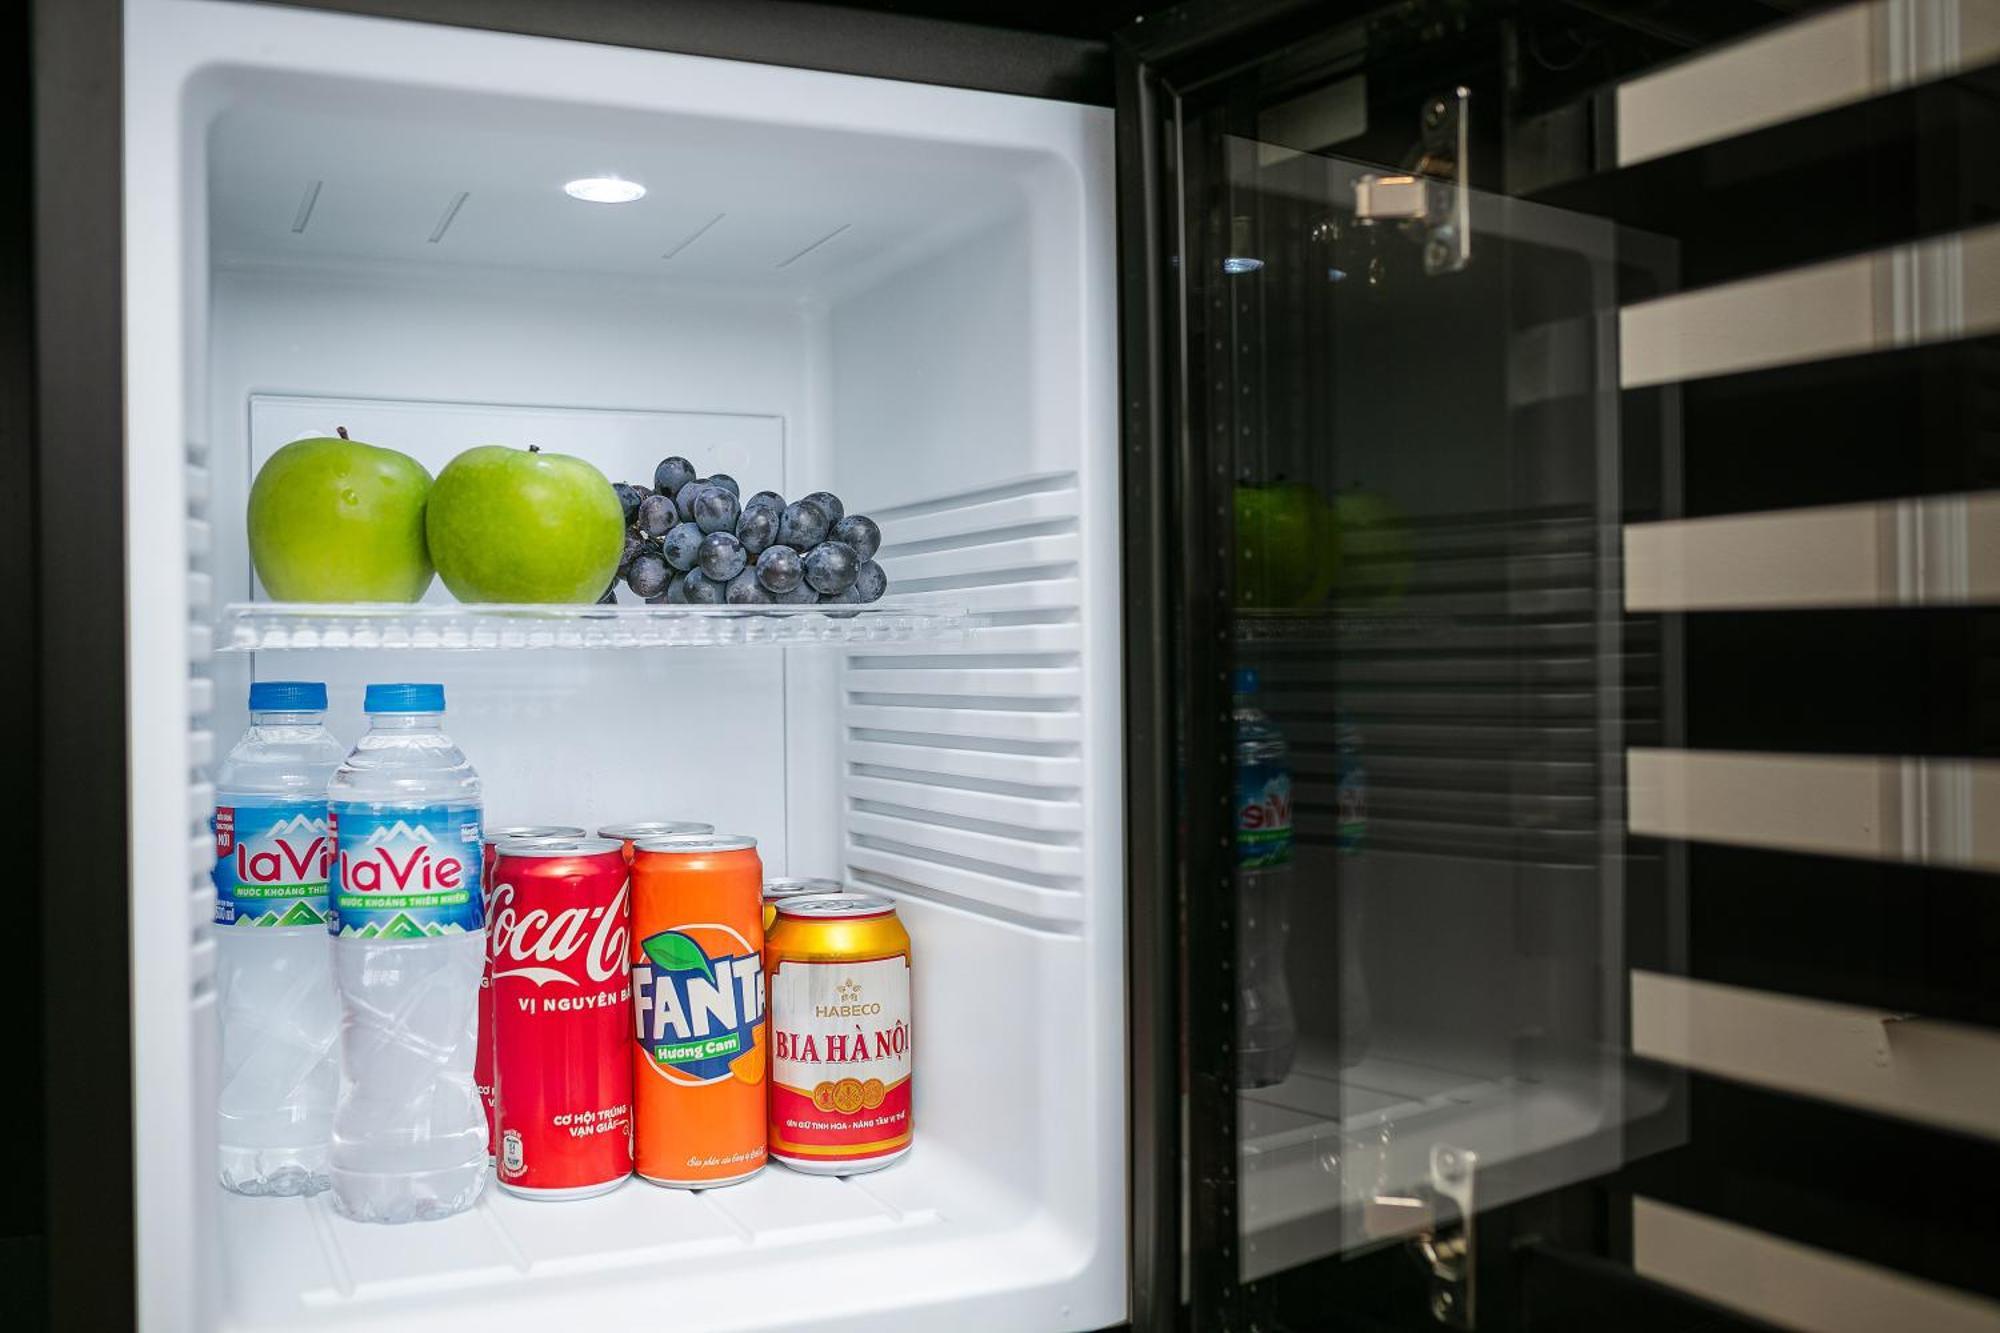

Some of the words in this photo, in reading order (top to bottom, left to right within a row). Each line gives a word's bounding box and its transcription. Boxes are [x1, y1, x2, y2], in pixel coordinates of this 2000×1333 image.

[237, 836, 328, 882] laVi
[341, 845, 463, 891] laVie
[264, 885, 305, 897] KHOÁNG
[518, 997, 536, 1015] VỊ
[543, 990, 617, 1012] NGUYÊN
[816, 1003, 881, 1018] HABECO
[706, 1037, 737, 1053] Cam
[776, 1030, 820, 1062] BIA
[825, 1024, 873, 1062] HÀ
[875, 1019, 909, 1060] NỘI
[553, 1113, 572, 1126] CƠ
[574, 1110, 595, 1125] HỘI
[569, 1124, 594, 1138] VẠN
